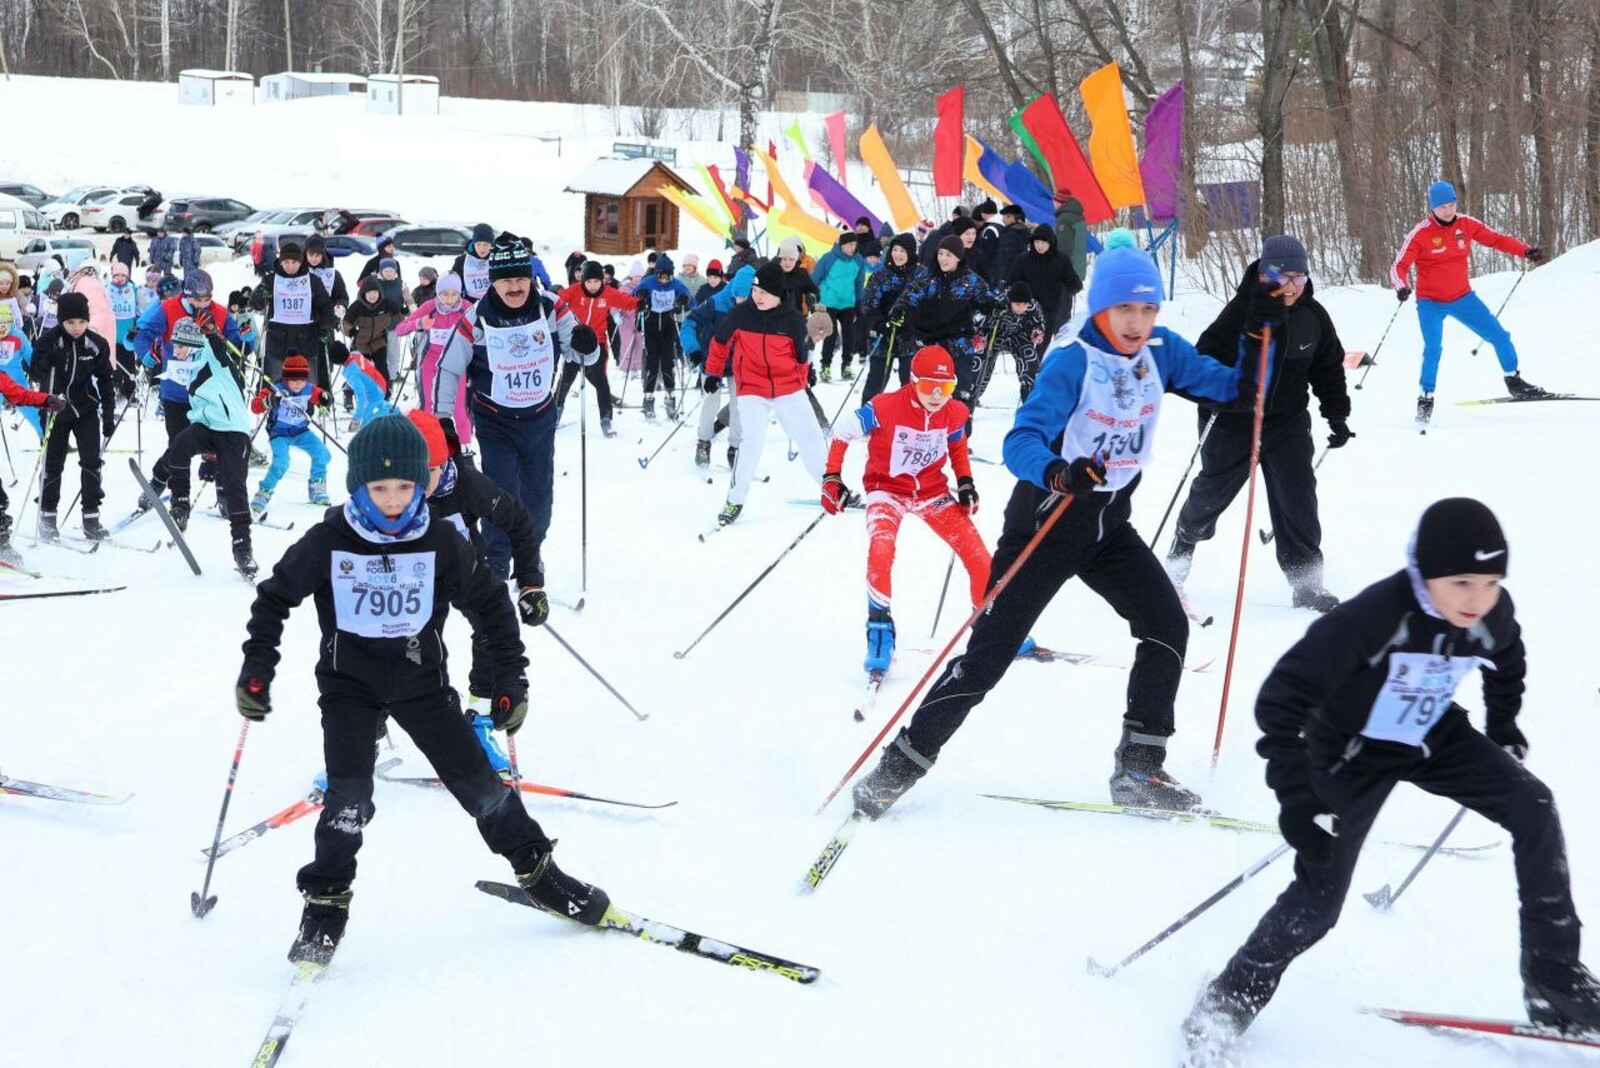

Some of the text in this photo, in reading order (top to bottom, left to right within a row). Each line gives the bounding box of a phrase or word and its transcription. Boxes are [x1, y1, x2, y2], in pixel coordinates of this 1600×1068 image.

[472, 278, 492, 290] 139
[281, 298, 304, 310] 1387
[504, 368, 542, 389] 1476
[352, 586, 421, 617] 7905
